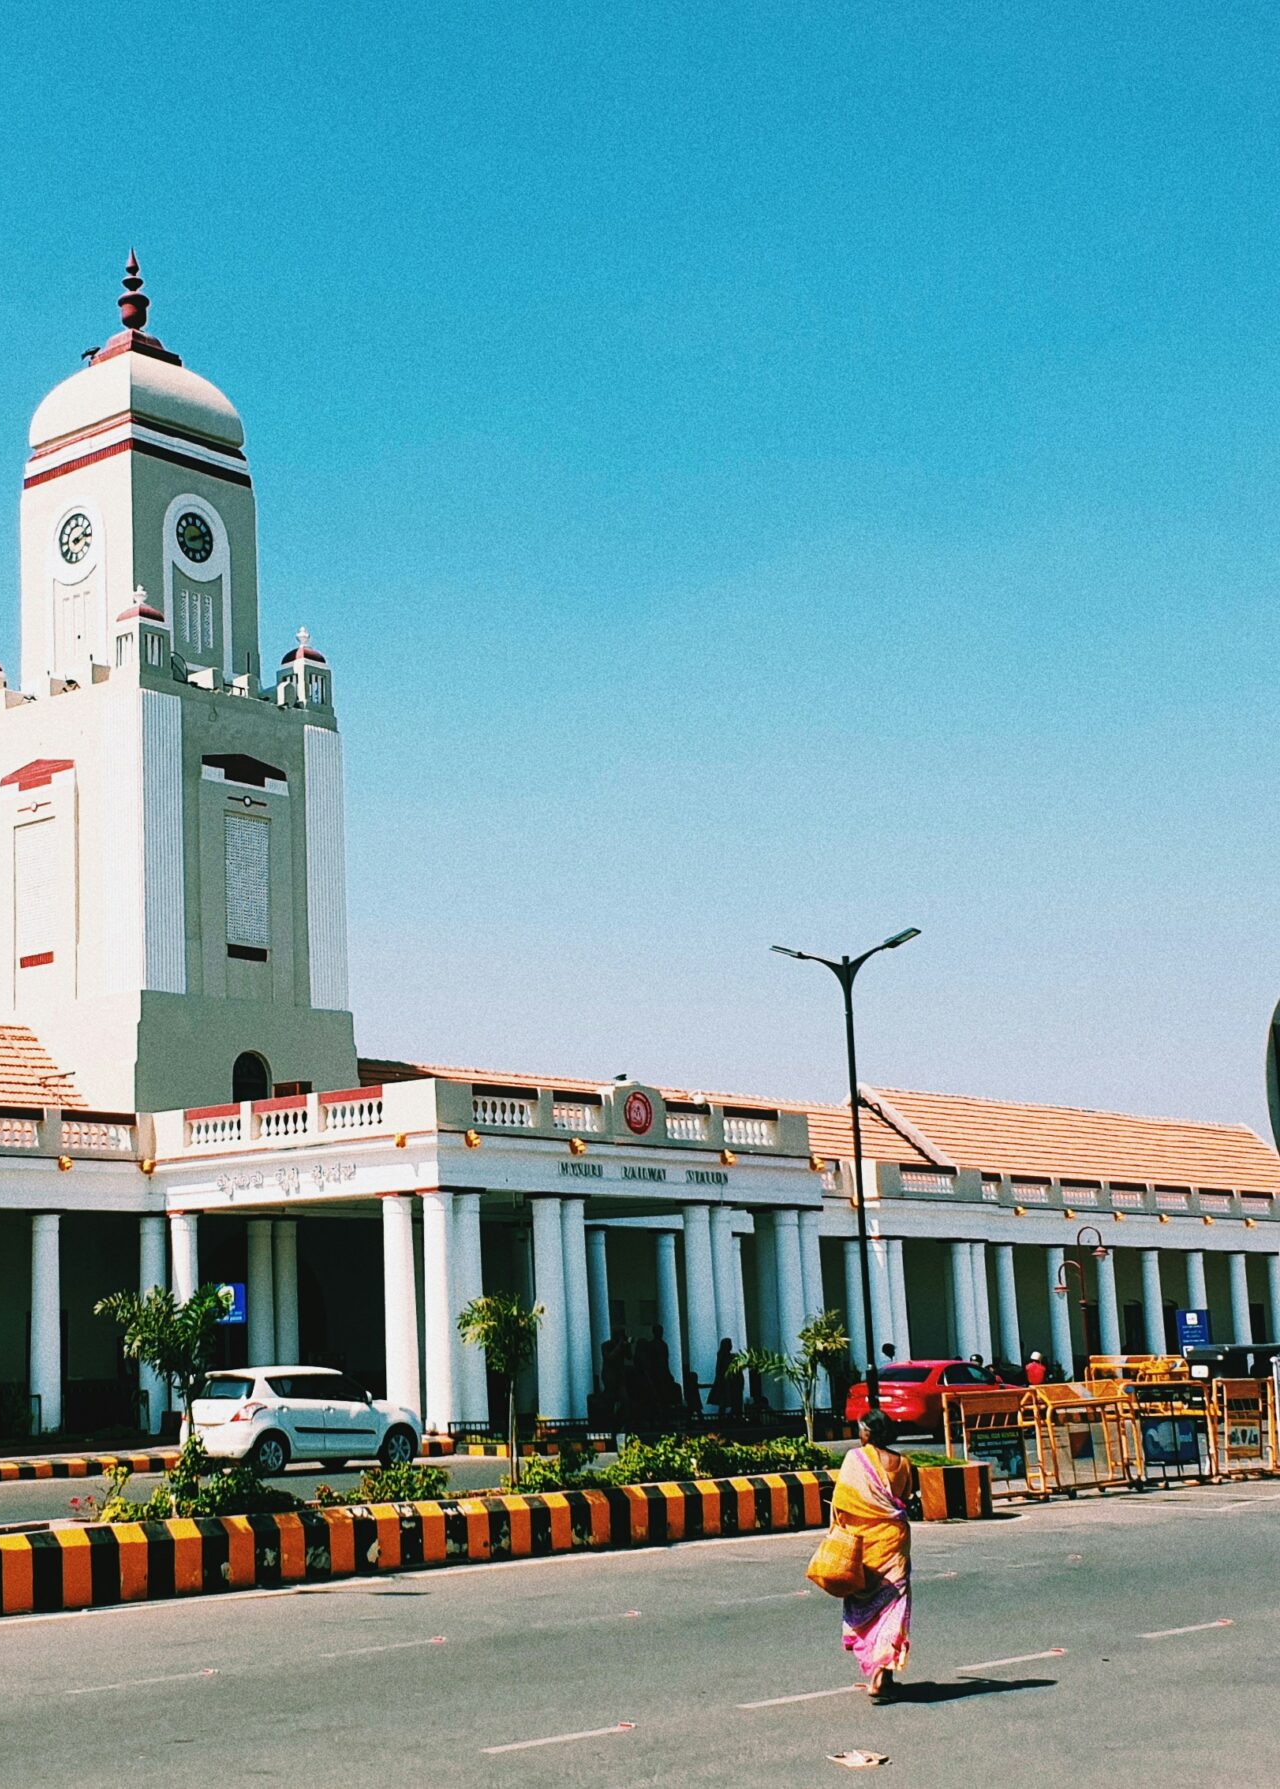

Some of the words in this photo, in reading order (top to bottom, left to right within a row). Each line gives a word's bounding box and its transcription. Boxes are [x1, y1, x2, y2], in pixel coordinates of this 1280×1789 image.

[558, 1161, 604, 1178] MYSURU
[622, 1165, 667, 1182] RAILWAY
[685, 1169, 729, 1186] STATION
